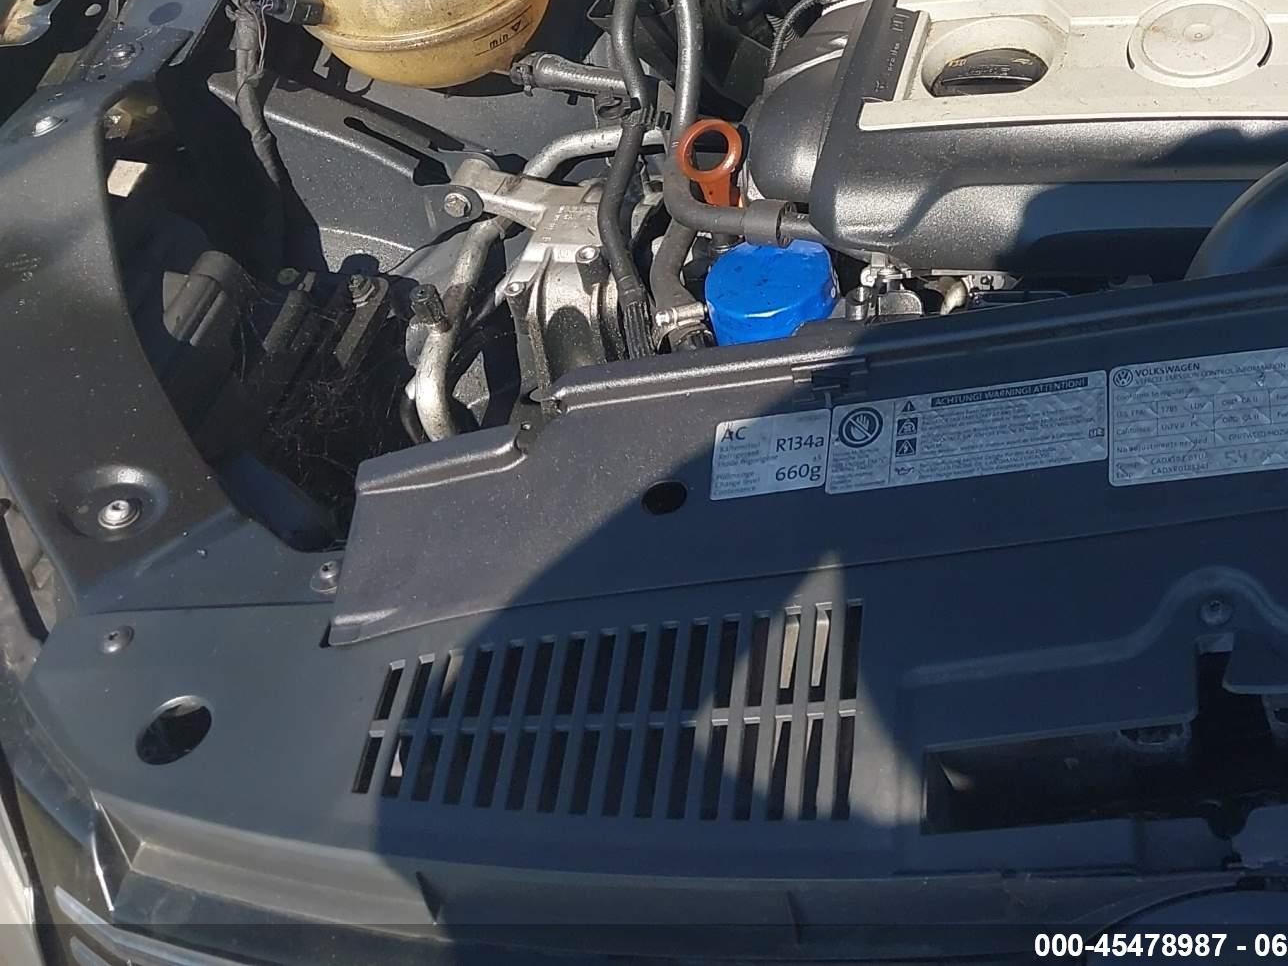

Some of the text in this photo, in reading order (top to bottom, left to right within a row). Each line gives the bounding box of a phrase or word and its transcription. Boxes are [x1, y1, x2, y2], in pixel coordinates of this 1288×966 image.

[489, 34, 509, 49] min
[1134, 362, 1200, 376] VOLKSWAGEN
[1200, 368, 1233, 377] CONTROL
[934, 378, 1085, 406] ACHTUNG! WARNING! ATTENTION!
[721, 425, 748, 442] AC
[775, 434, 825, 453] R134a
[775, 463, 822, 482] 660g
